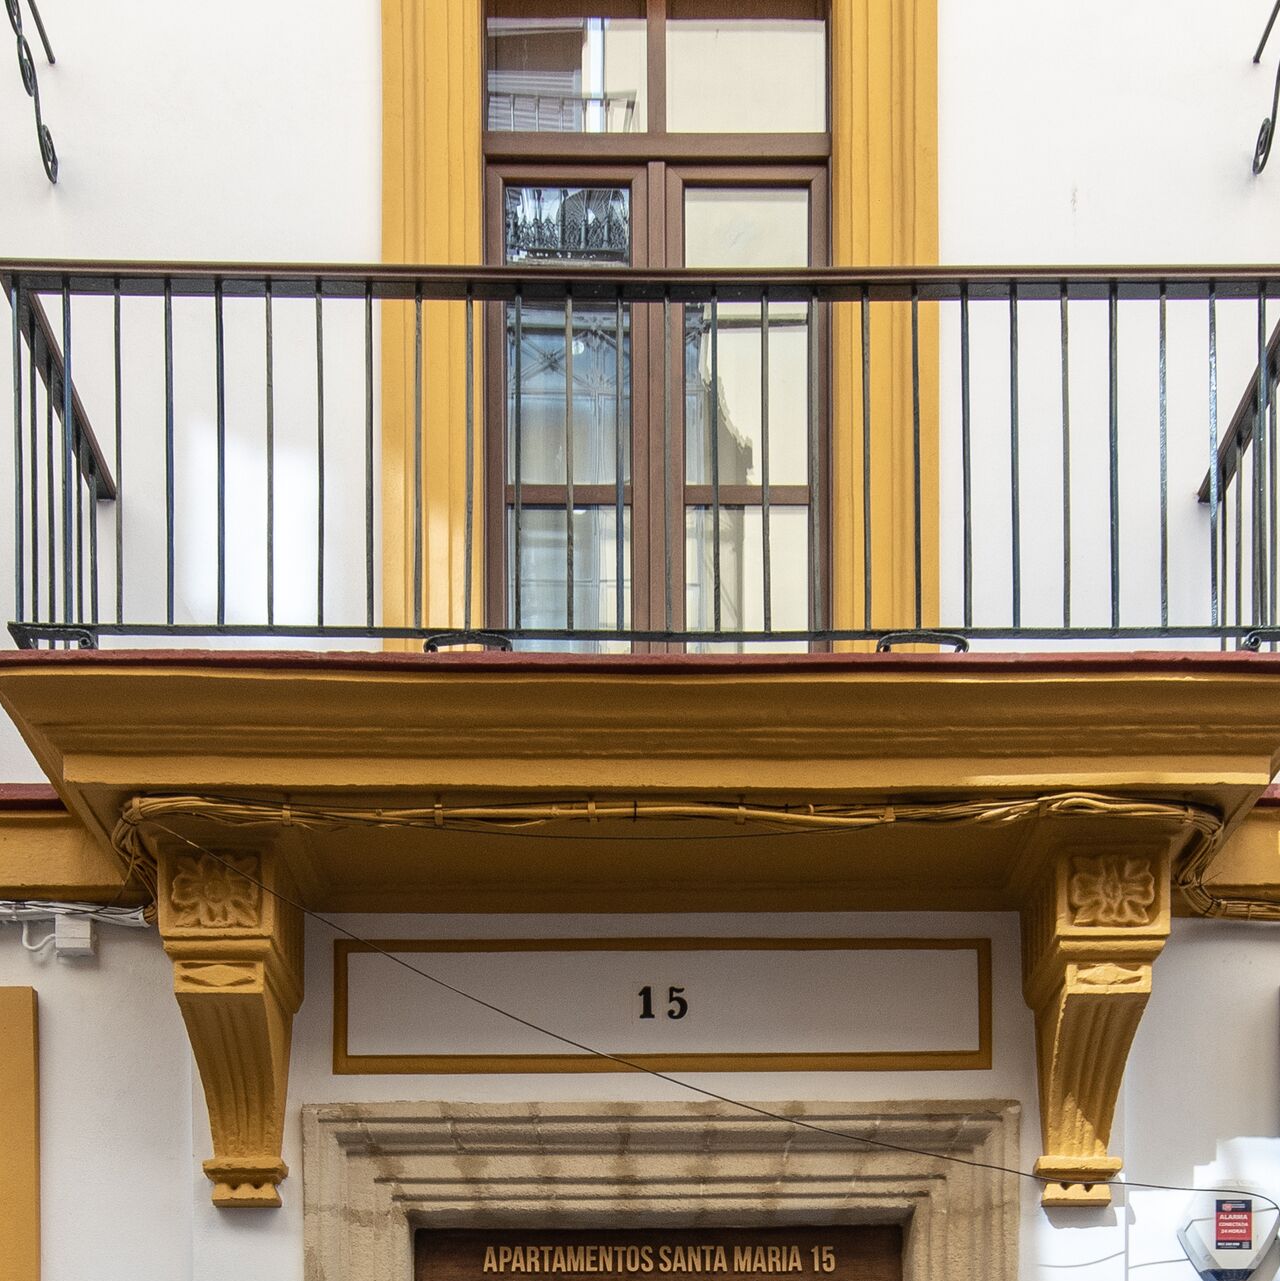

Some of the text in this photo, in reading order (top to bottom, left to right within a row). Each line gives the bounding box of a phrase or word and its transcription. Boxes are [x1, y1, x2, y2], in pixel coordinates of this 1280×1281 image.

[638, 986, 688, 1020] 15
[483, 1246, 836, 1273] APARTAMENTOS SANTA MARIA 15
